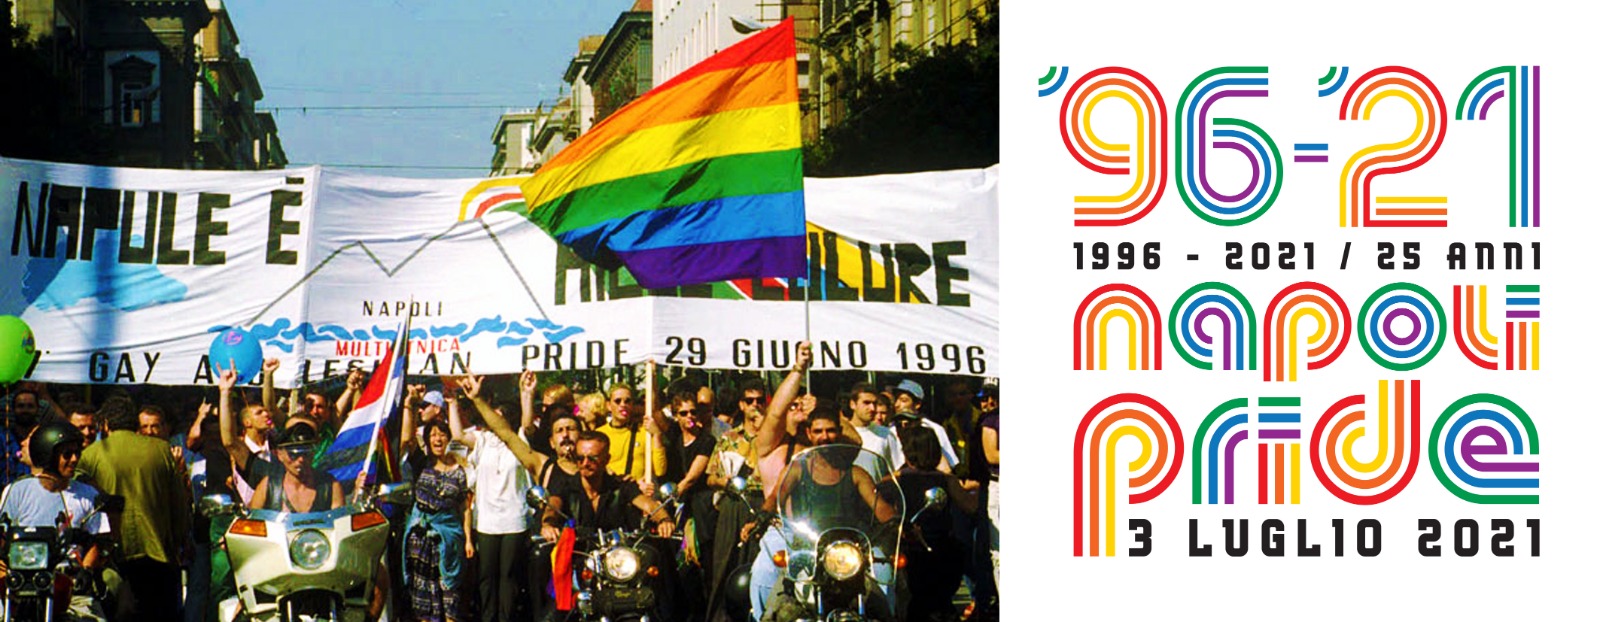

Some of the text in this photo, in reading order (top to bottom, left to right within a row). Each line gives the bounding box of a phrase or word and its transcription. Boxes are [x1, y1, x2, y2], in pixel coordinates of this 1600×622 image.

[11, 181, 230, 265] NAPULE
[363, 301, 442, 317] NAPOLI
[88, 352, 161, 382] GAY
[522, 338, 629, 371] PRIDE
[665, 336, 706, 366] 29
[896, 341, 986, 374] 1996
[335, 337, 460, 357] MULTITNICA
